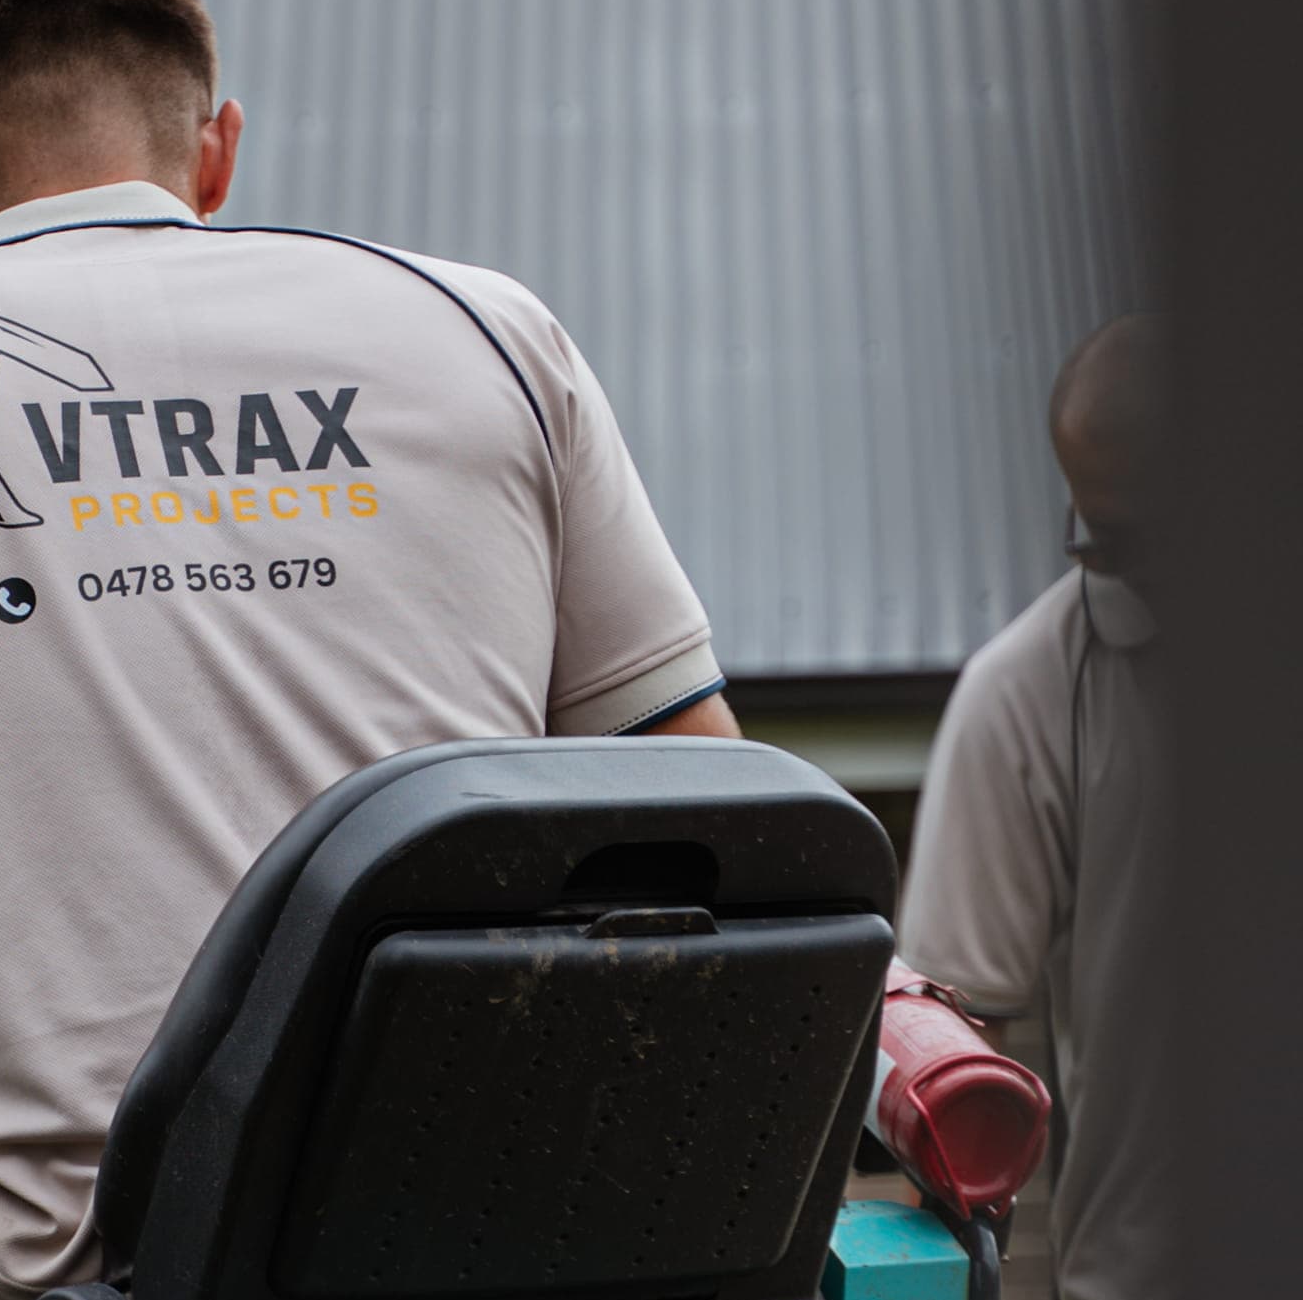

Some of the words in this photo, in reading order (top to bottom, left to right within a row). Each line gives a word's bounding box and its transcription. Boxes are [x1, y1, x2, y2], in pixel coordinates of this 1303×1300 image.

[21, 386, 372, 484] VTRAX
[68, 481, 381, 532] PROJECTS
[77, 562, 176, 603] 0478
[183, 562, 257, 593] 563
[267, 556, 338, 591] 679
